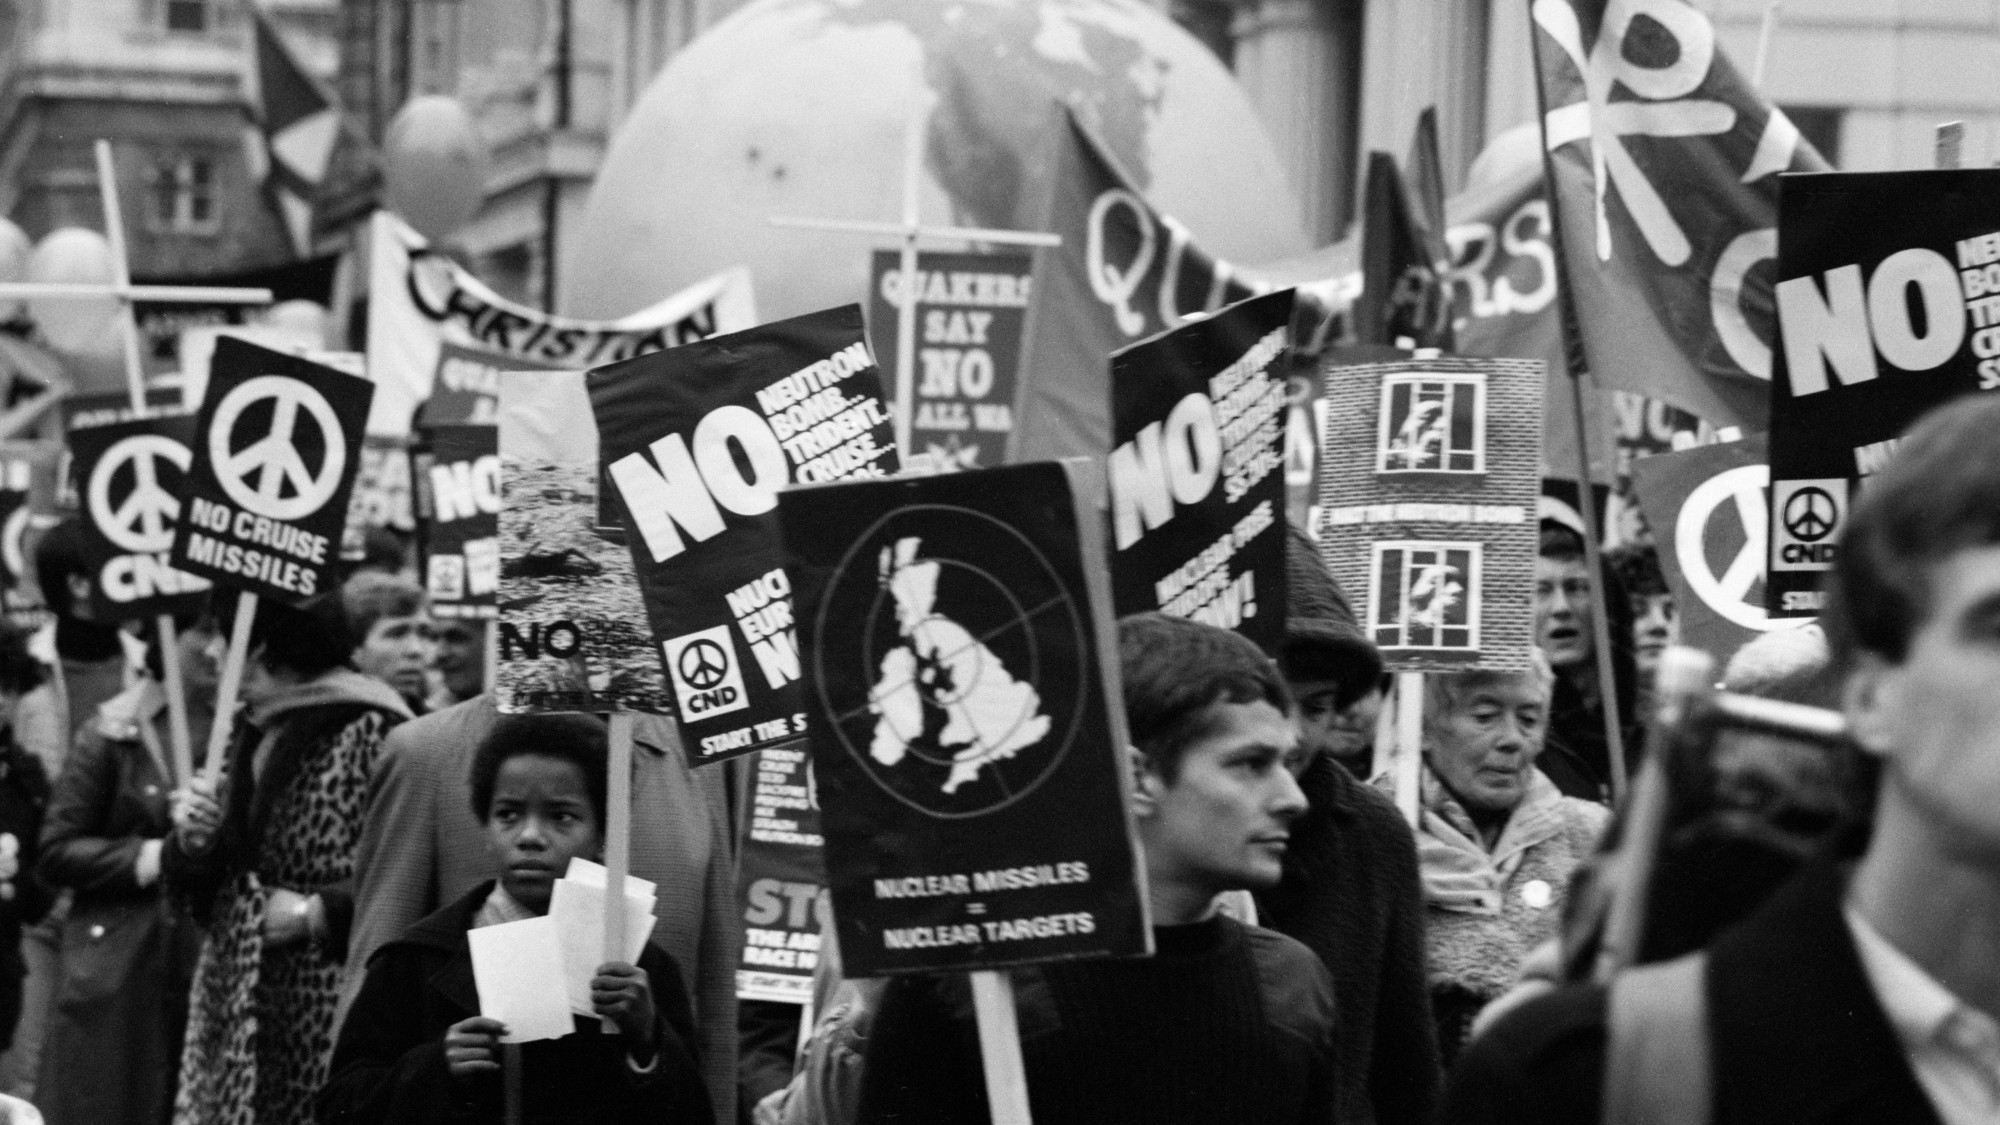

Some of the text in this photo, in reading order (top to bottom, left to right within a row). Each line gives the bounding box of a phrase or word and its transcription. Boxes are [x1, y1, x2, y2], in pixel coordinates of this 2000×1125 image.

[923, 309, 995, 344] SAY
[1774, 247, 1968, 397] NO
[755, 341, 874, 416] NEUTRON
[918, 347, 996, 400] NO
[767, 386, 866, 442] BOMB...
[914, 402, 971, 430] ALL
[431, 453, 500, 523] NO
[608, 404, 790, 563] NO
[1106, 392, 1223, 552] NO
[189, 496, 329, 566] NO CRUISE
[186, 532, 319, 596] MISSILES
[1781, 543, 1841, 564] CND
[501, 620, 582, 661] NO
[687, 685, 738, 714] CND
[700, 726, 753, 756] START
[752, 717, 791, 741] THE
[873, 860, 1091, 899] NUCLEAR MISSILES
[745, 926, 788, 948] THE
[882, 911, 1097, 949] NUCLEAR TARGETS
[743, 945, 797, 969] RACE
